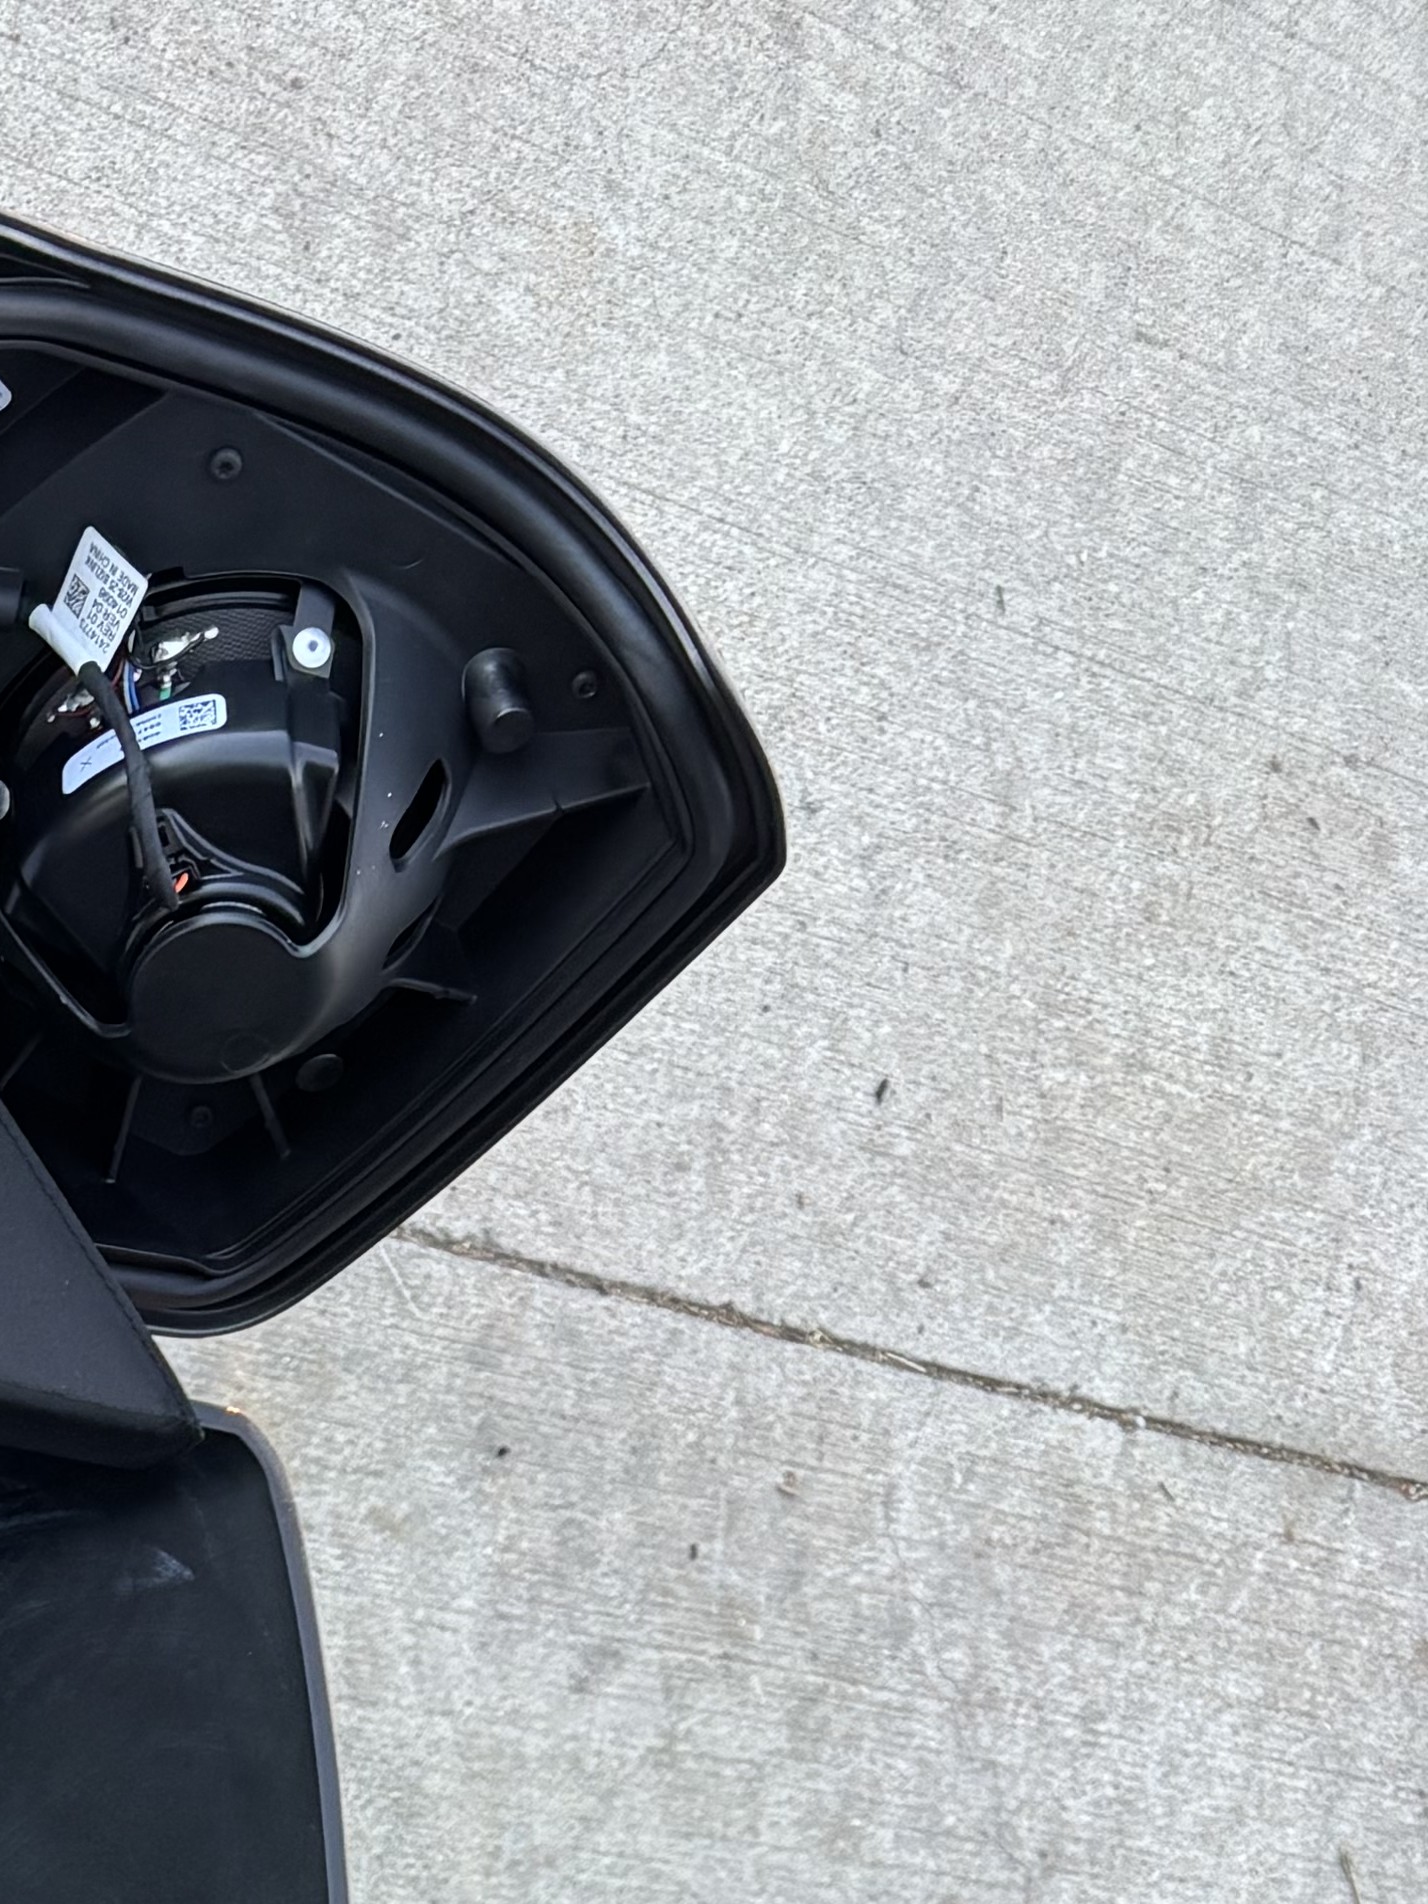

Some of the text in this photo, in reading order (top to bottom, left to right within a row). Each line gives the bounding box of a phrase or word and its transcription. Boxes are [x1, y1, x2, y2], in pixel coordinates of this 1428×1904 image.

[89, 541, 111, 567] CHINA
[116, 567, 139, 595] MADE
[86, 610, 117, 643] REV 01
[101, 611, 121, 631] VER
